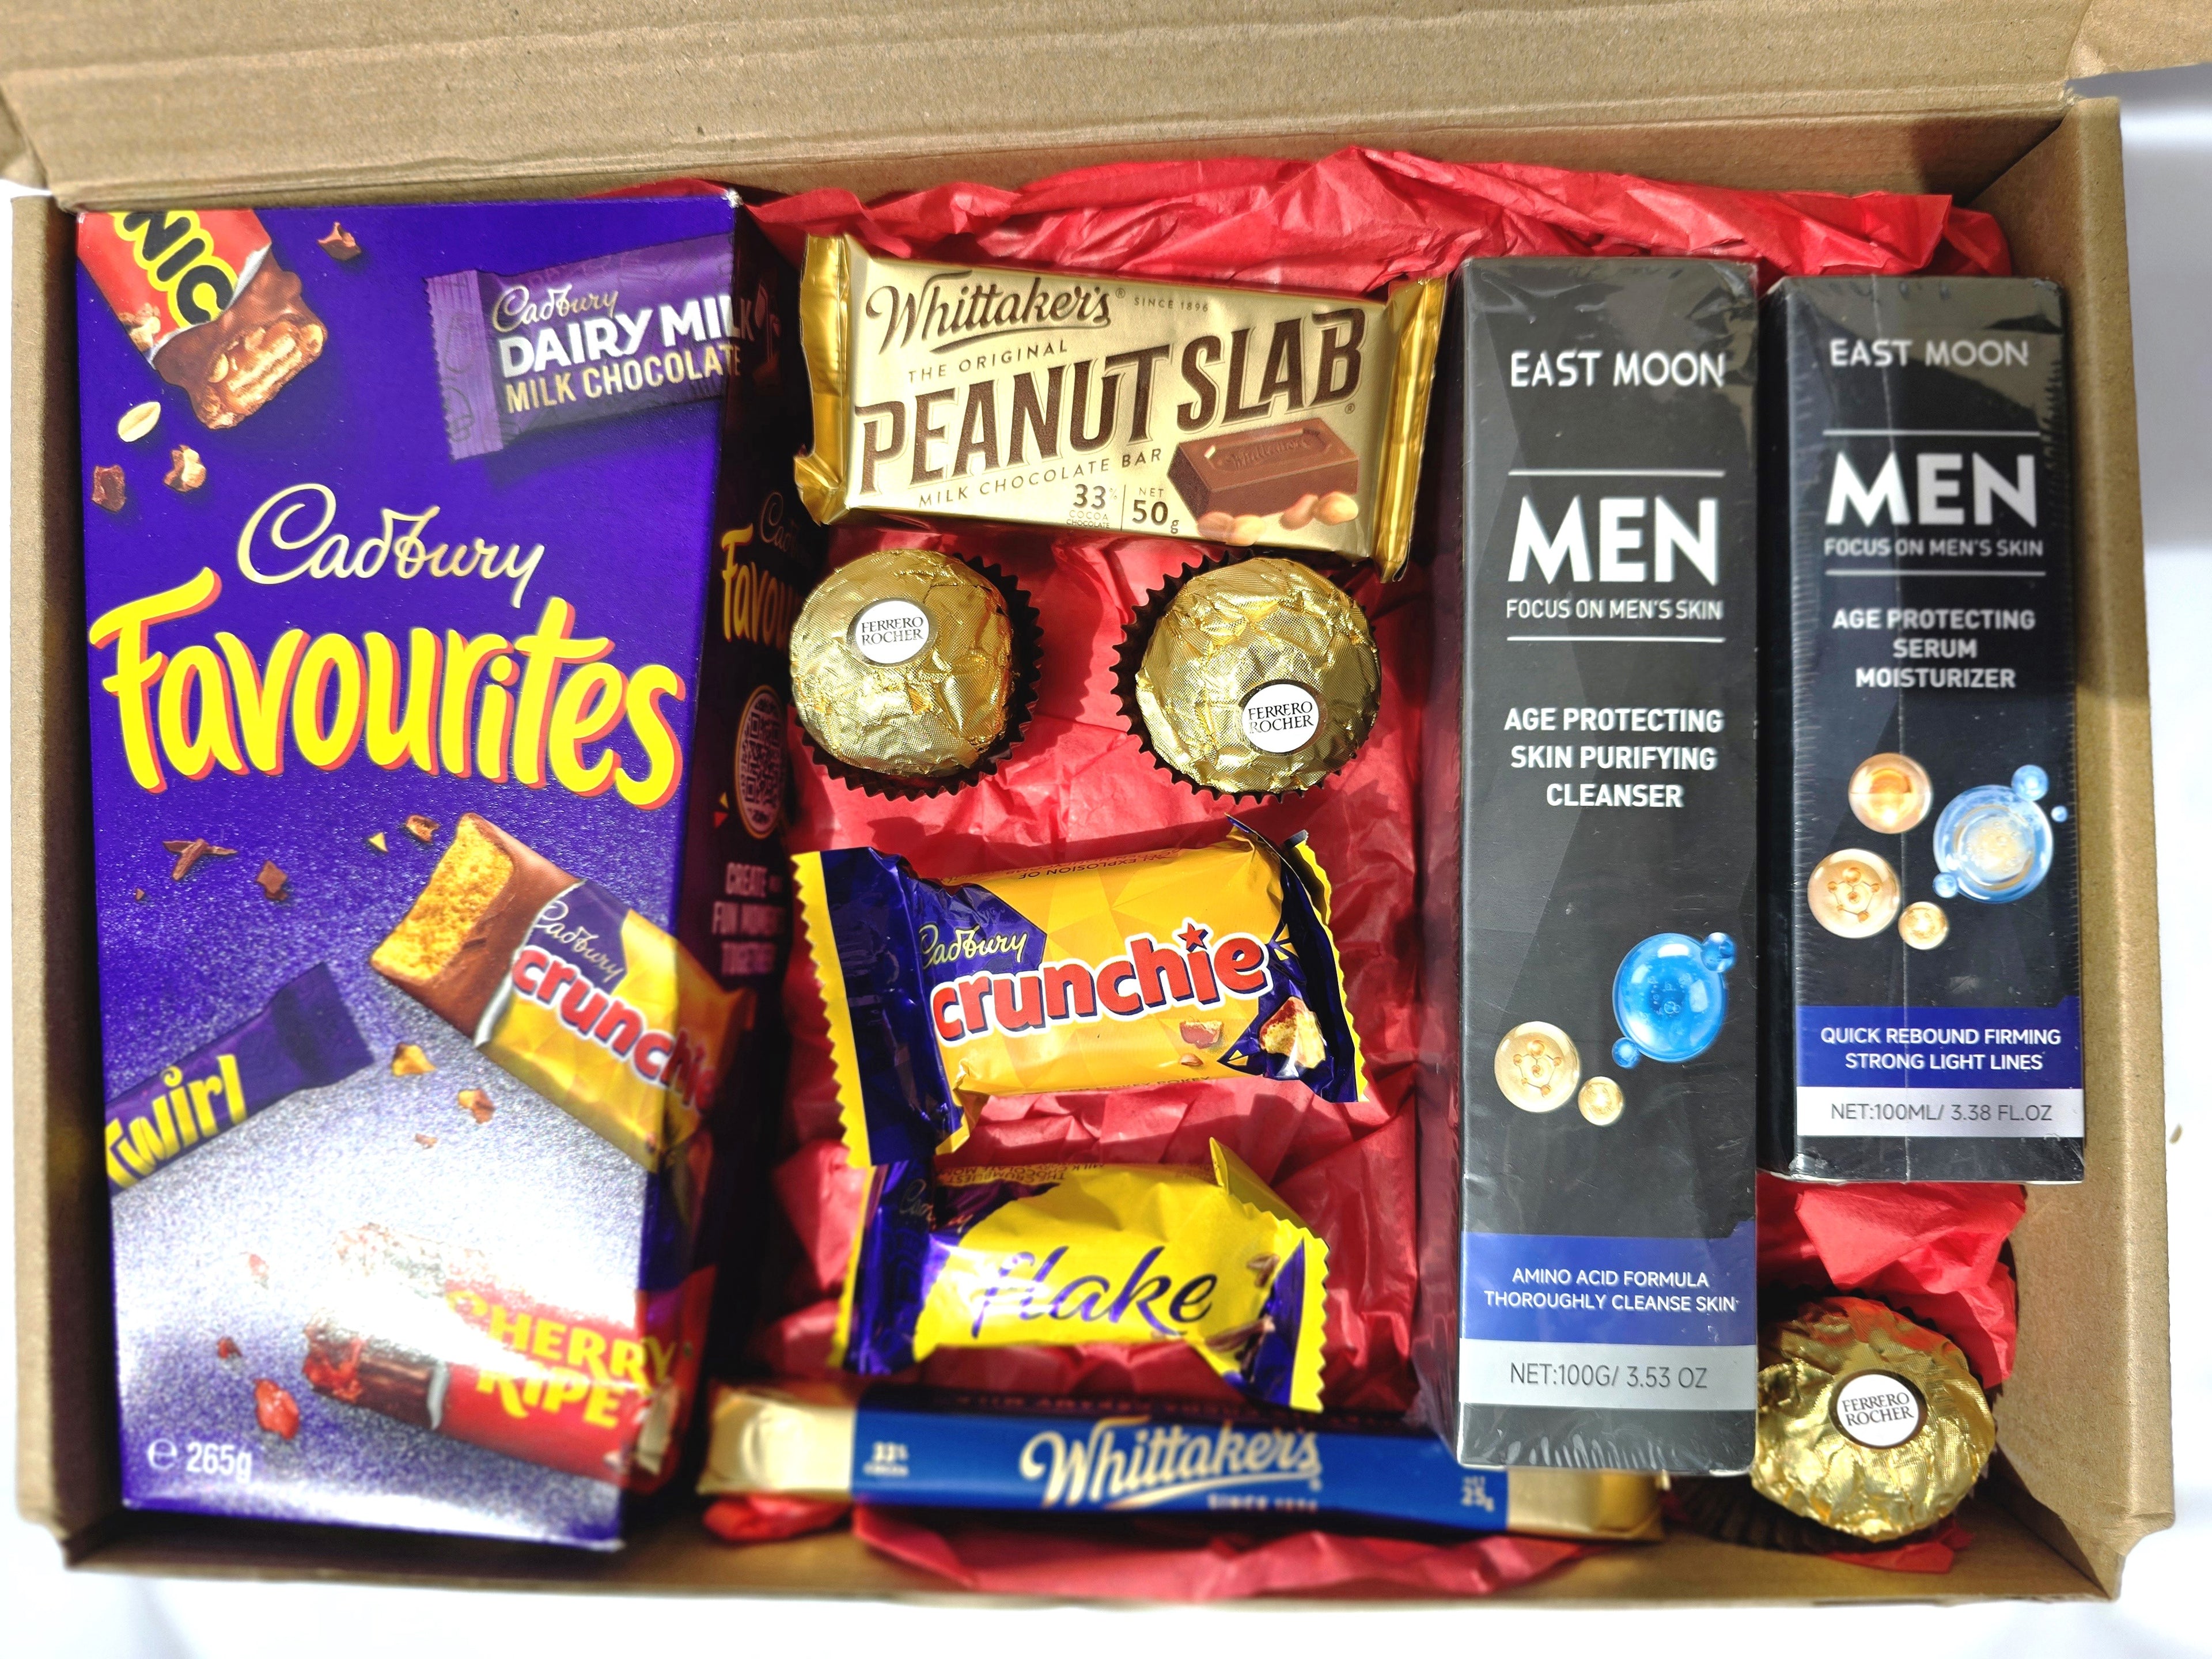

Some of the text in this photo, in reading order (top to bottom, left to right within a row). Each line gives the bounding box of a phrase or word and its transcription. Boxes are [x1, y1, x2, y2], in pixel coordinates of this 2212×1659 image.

[490, 283, 619, 333] Cadbury
[866, 270, 1112, 355] Whittaker's
[1134, 296, 1209, 313] SINCE 1896
[498, 308, 653, 378] DAIRY
[1828, 339, 2029, 367] EAST MOON
[909, 339, 1068, 384] THE ORIGINAL
[1510, 349, 1727, 388] EAST MOON
[503, 343, 742, 414] MILK CHOCOLATE
[855, 308, 1366, 495] PEANUT SLAB
[919, 448, 1162, 507] MILK CHOCOLATE BAR
[1825, 451, 2037, 528] MEN
[1139, 487, 1164, 497] NET
[1069, 509, 1108, 521] COCOA
[236, 483, 545, 609] Cadbury
[1508, 494, 1718, 586] MEN
[1823, 538, 2044, 557] FOCUS ON MEN'S SKIN
[1506, 598, 1725, 621] FOCUS ON MEN'S SKIN
[1831, 608, 2037, 630] AGE PROTECTING
[861, 616, 924, 633] FERRERO
[861, 628, 925, 646] ROCHER
[1892, 638, 1978, 659] SERUM
[89, 566, 686, 810] Favourites
[1855, 667, 2017, 689] MOISTURIZER
[1248, 701, 1313, 720] FERRERO
[1503, 707, 1725, 733] AGE PROTECTING
[1249, 714, 1315, 734] ROCHER
[1510, 745, 1718, 771] SKIN PURIFYING
[1546, 783, 1685, 808] CLEANSER
[1018, 871, 1041, 880] OF
[1046, 858, 1136, 876] EXPLOSION
[533, 900, 626, 983] Cadbury
[920, 923, 1029, 971] Cadbury
[930, 921, 1270, 1043] crunchie
[1820, 1027, 2062, 1046] QUICK REBOUND FIRMING
[1844, 1052, 2044, 1071] STRONG LIGHT LINES
[1950, 1104, 1992, 1122] 3.38
[1997, 1104, 2053, 1122] FL.OZ
[1512, 1267, 1710, 1288] AMINO ACID FORMULA
[971, 1244, 1218, 1339] flake
[1484, 1290, 1737, 1313] THOROUGHLY CLEANSE SKIN
[1626, 1365, 1672, 1388] 3.53
[1677, 1366, 1709, 1389] OZ
[1842, 1392, 1910, 1412] FERRERO
[1845, 1406, 1915, 1427] ROCHER
[186, 1441, 253, 1484] 265g
